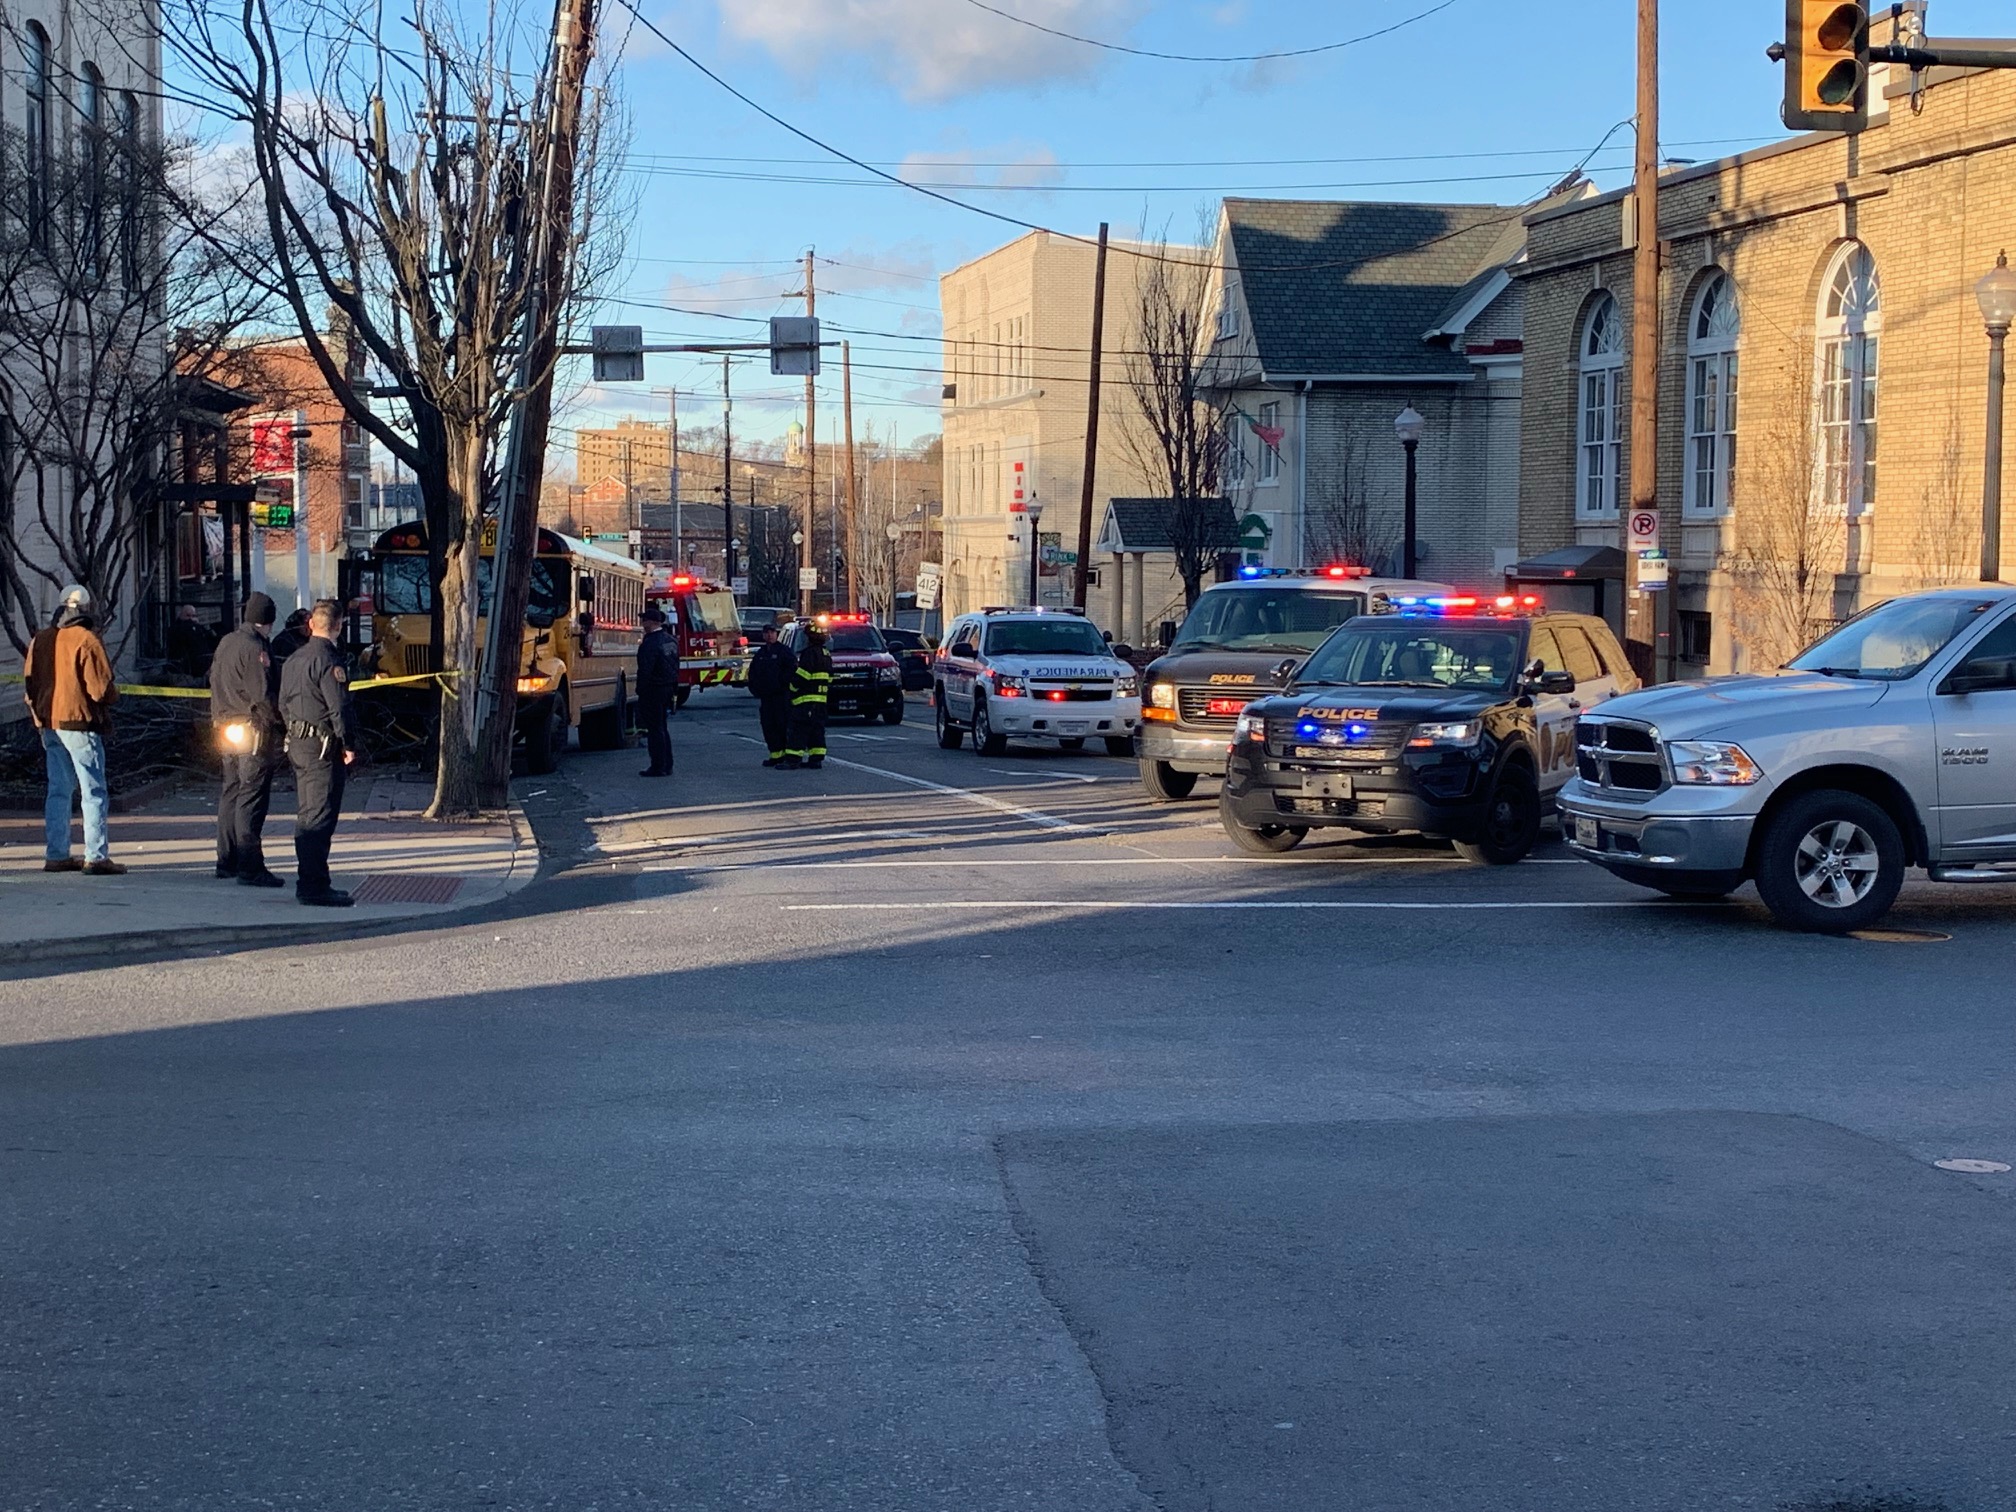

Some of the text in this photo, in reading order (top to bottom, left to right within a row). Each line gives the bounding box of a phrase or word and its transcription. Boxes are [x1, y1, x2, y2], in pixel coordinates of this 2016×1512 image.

[918, 578, 937, 592] 412
[1209, 674, 1256, 684] POLICE
[1297, 706, 1379, 720] POLICE
[1942, 747, 1988, 756] RAM
[1942, 757, 1988, 765] 1500
